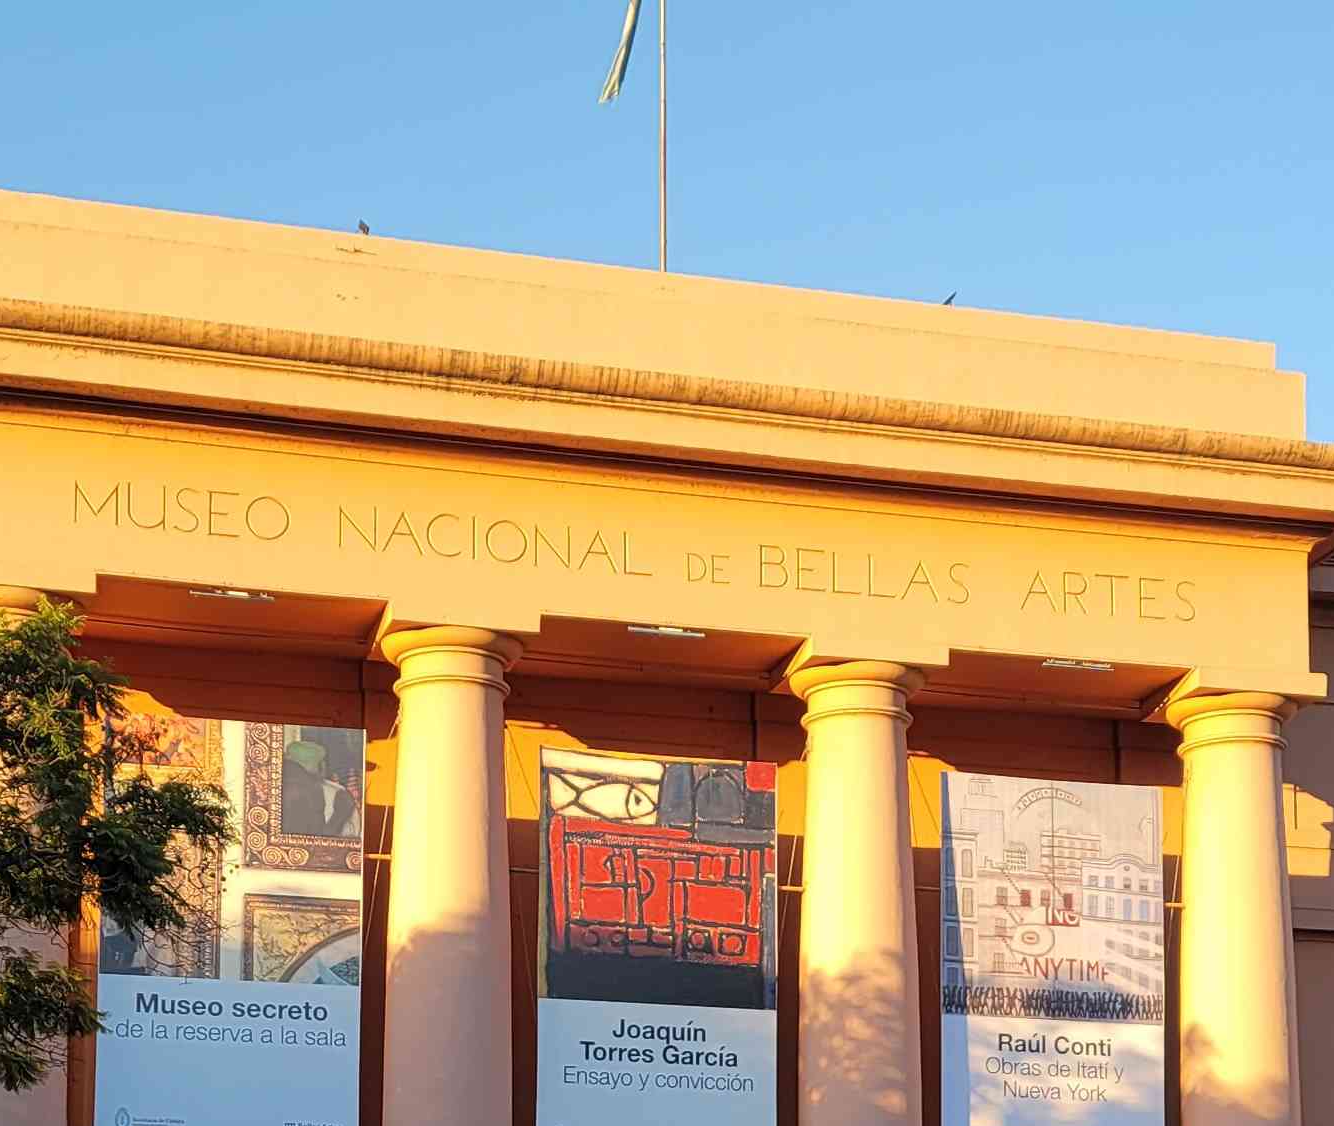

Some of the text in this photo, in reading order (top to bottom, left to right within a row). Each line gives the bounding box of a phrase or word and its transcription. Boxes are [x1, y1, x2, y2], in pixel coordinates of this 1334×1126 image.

[73, 480, 1196, 622] MUSEO NACIONAL DE BELLAS ARTES
[135, 992, 328, 1022] Museo secreto
[115, 1019, 347, 1047] de la reserva a la sala
[612, 1019, 707, 1045] Joaquín
[998, 1033, 1112, 1057] Raúl Conti
[580, 1041, 739, 1068] Torres García
[563, 1065, 754, 1093] Ensayo y convicción
[985, 1056, 1124, 1084] Obras de Itatí y
[1003, 1080, 1108, 1103] Nueva York
